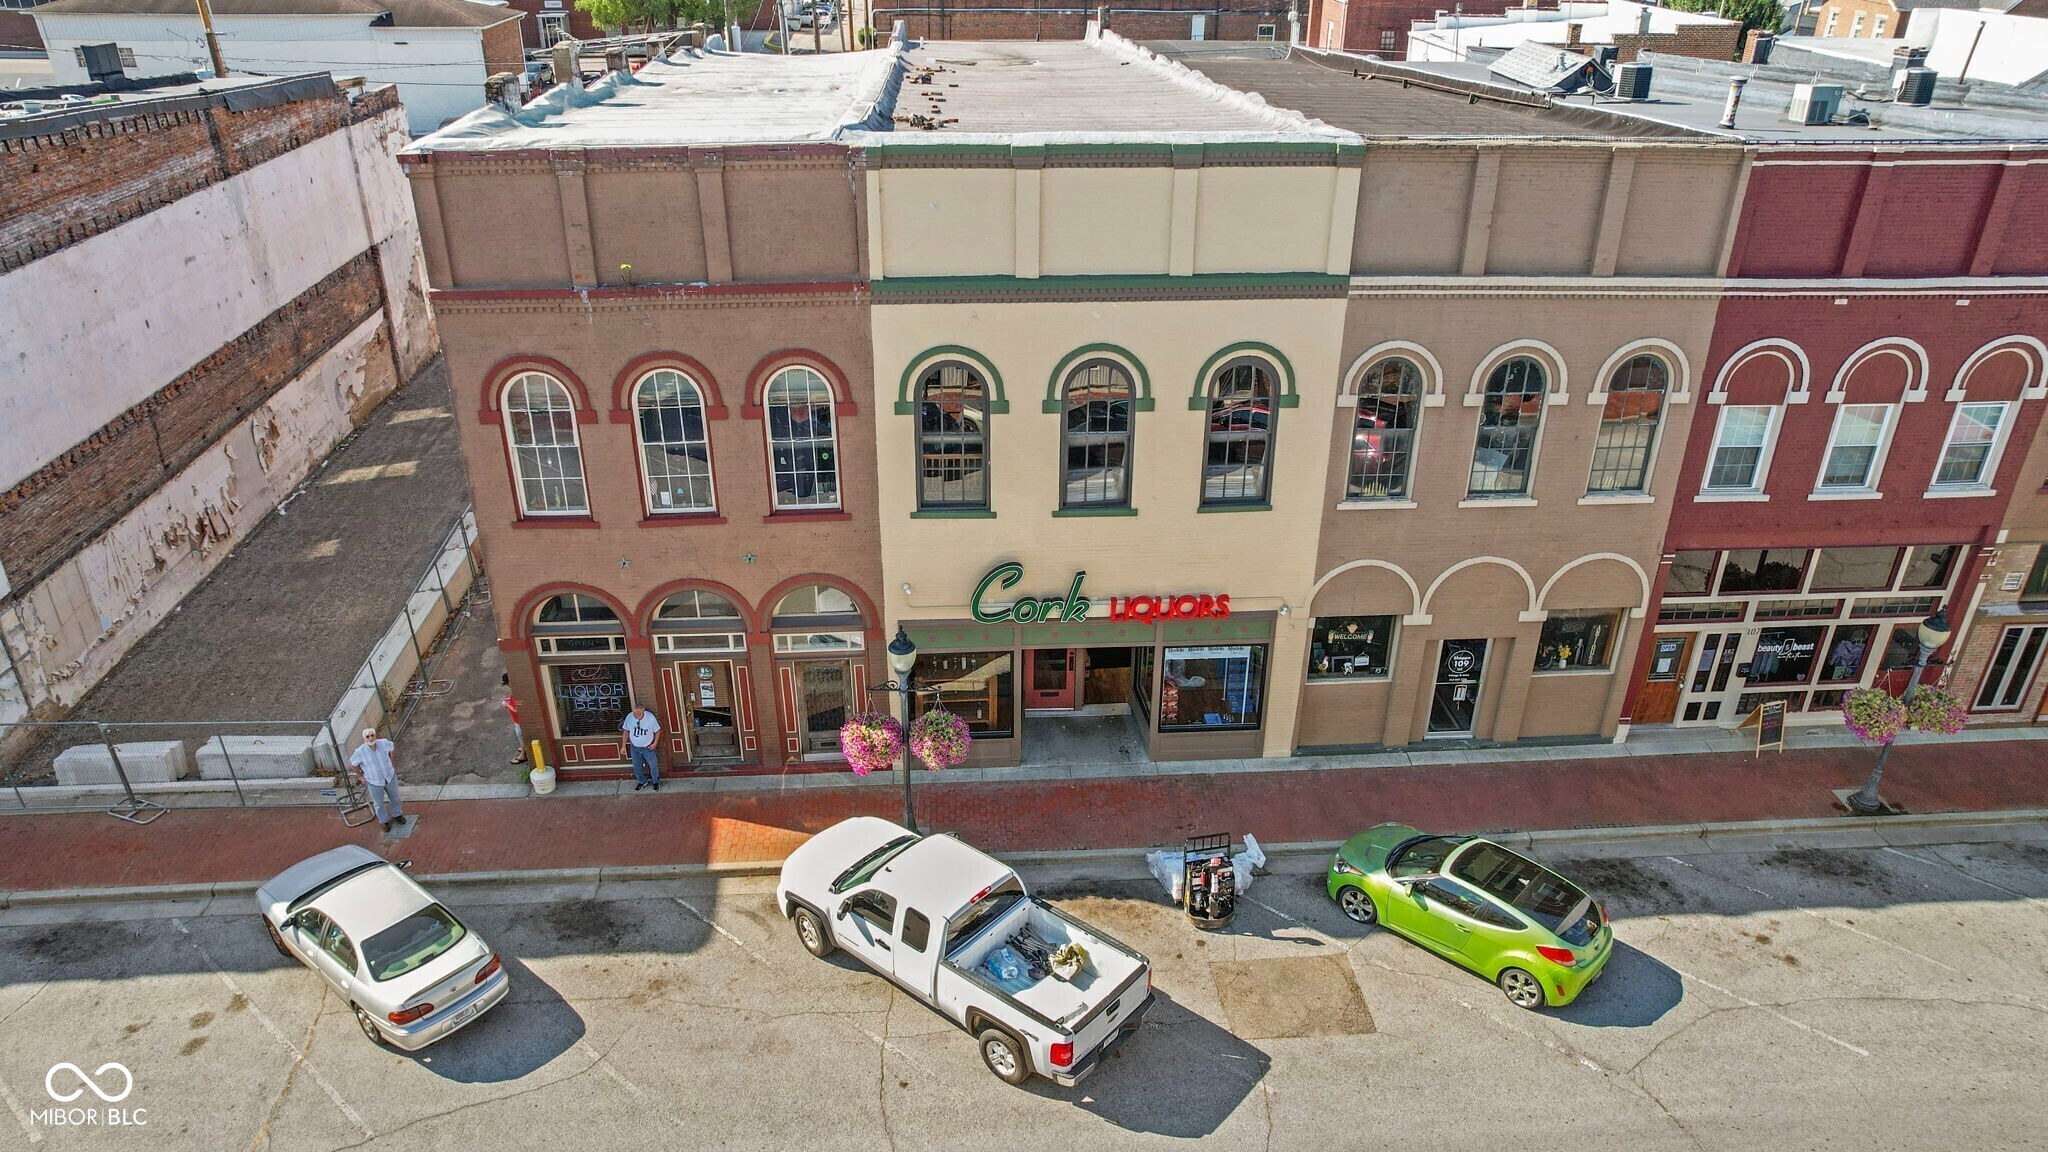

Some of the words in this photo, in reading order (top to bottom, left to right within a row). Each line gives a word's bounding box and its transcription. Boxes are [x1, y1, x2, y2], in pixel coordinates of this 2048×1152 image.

[970, 561, 1092, 624] Cork
[1109, 594, 1231, 625] LIQUORS
[1747, 627, 1761, 636] 107
[1757, 643, 1783, 654] beauty
[1792, 642, 1815, 651] beast
[558, 683, 624, 698] LIQUOR
[574, 697, 621, 710] BEER
[633, 726, 649, 737] Lite
